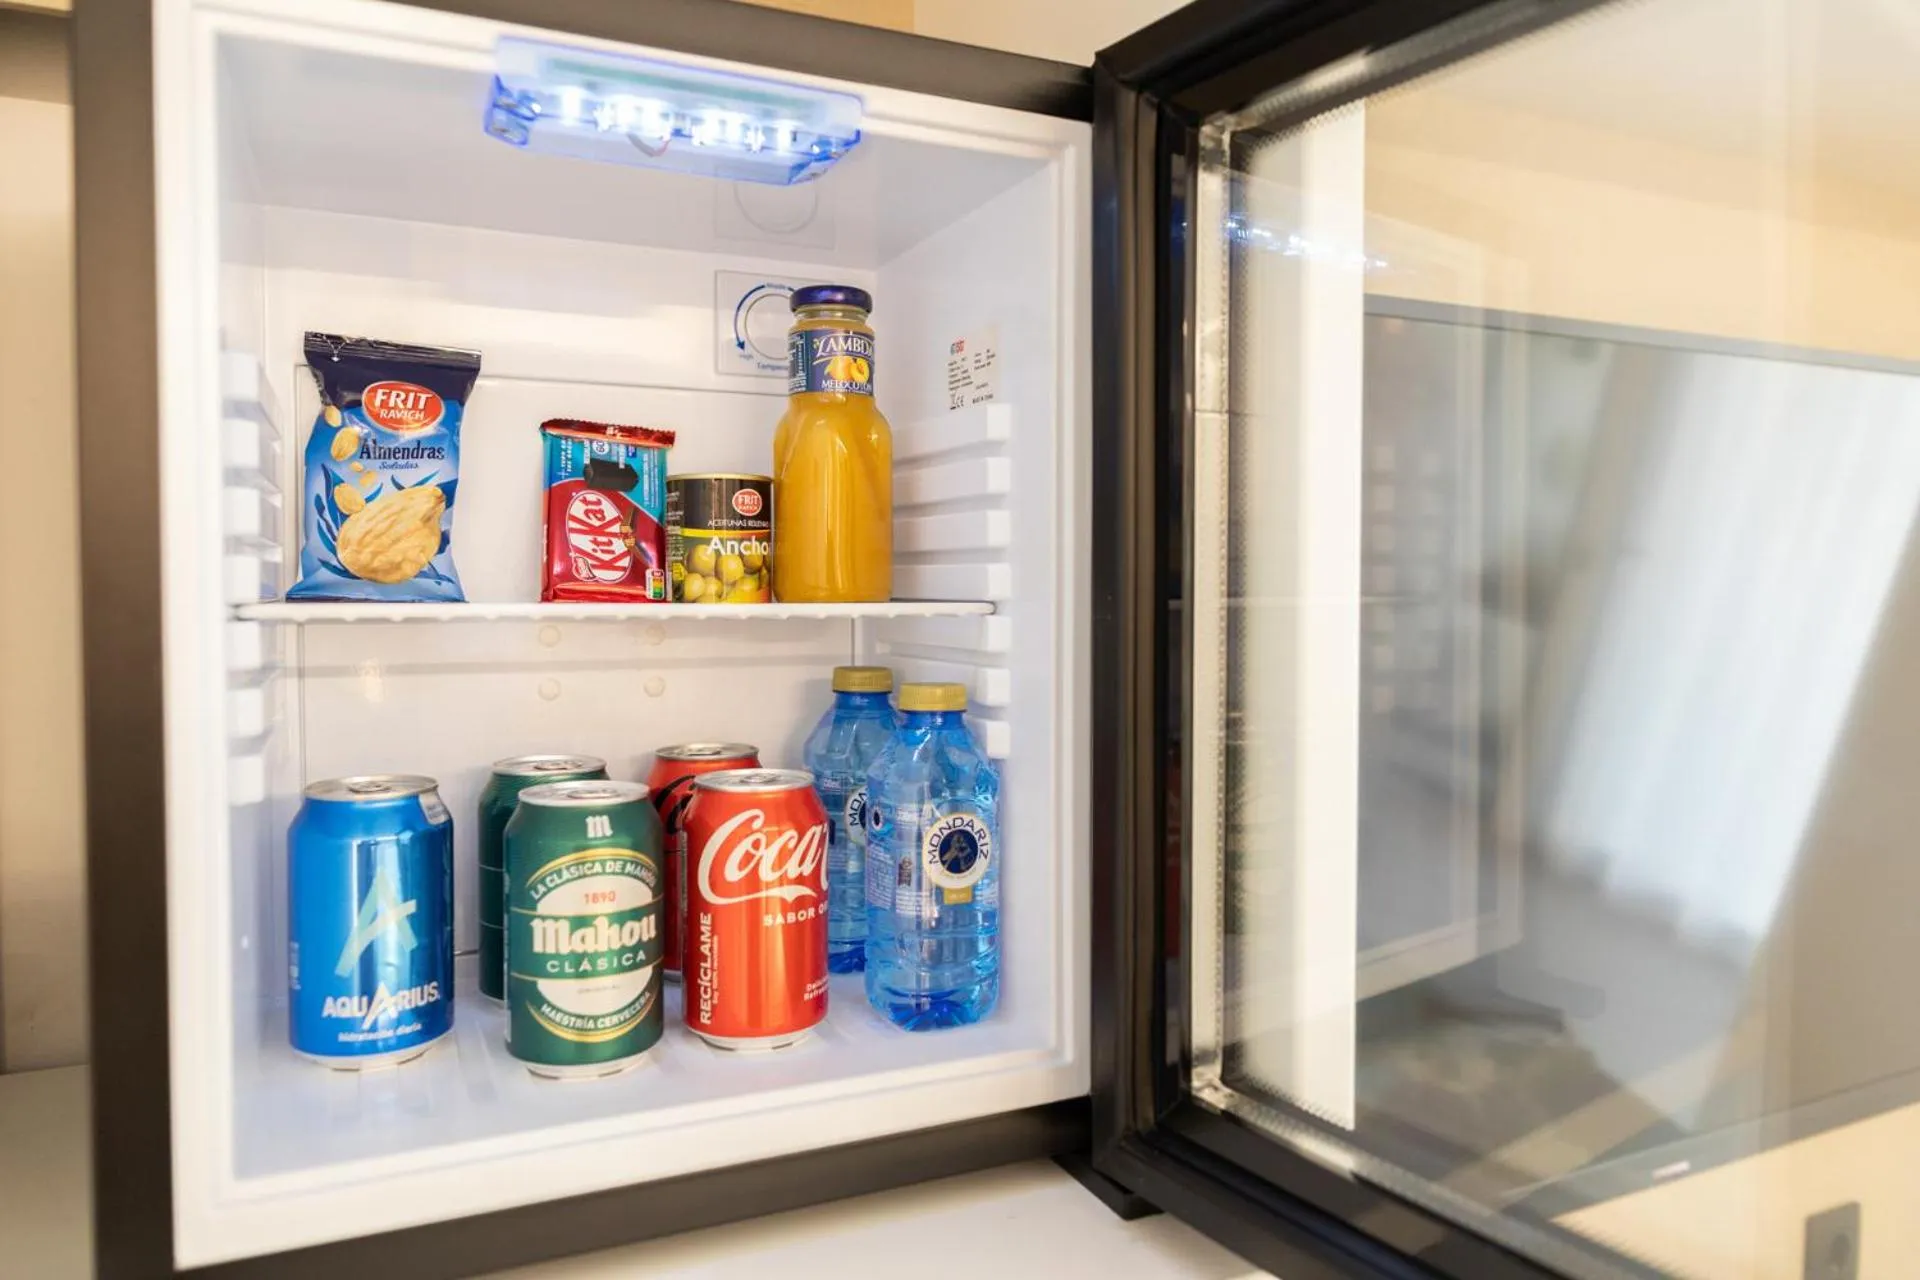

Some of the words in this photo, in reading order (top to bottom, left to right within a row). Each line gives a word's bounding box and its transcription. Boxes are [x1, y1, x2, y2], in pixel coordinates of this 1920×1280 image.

[374, 388, 433, 410] FRIT
[379, 408, 426, 421] RAVICH
[359, 439, 445, 460] Almendras
[738, 494, 759, 505] FRIT
[706, 534, 769, 557] Ancho
[928, 816, 989, 865] MONDARIZ
[530, 882, 547, 900] LA
[605, 860, 624, 874] DE
[584, 890, 617, 904] 1890
[762, 906, 816, 927] SABOR
[321, 981, 441, 1031] AQUARIUS
